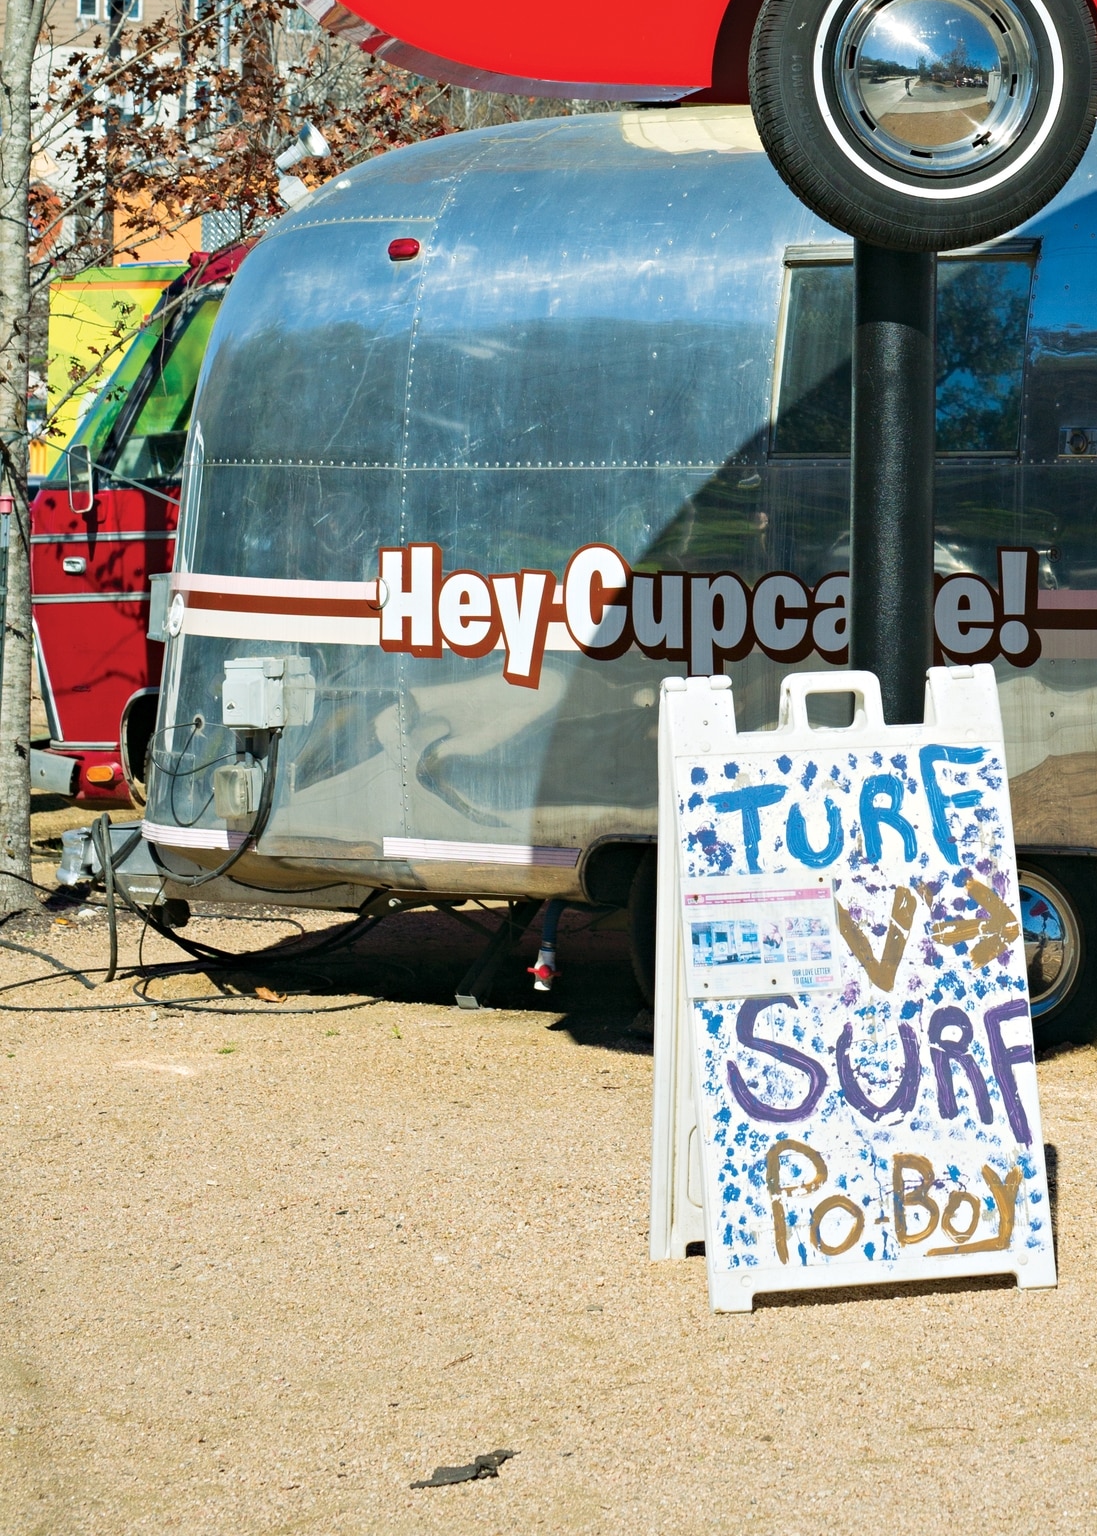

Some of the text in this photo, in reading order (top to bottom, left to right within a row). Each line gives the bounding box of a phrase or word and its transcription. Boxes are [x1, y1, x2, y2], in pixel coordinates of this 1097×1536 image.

[379, 542, 557, 689] Hey
[564, 542, 1043, 677] Cupcae!
[707, 744, 989, 875] TURF
[726, 995, 1033, 1150] SURF
